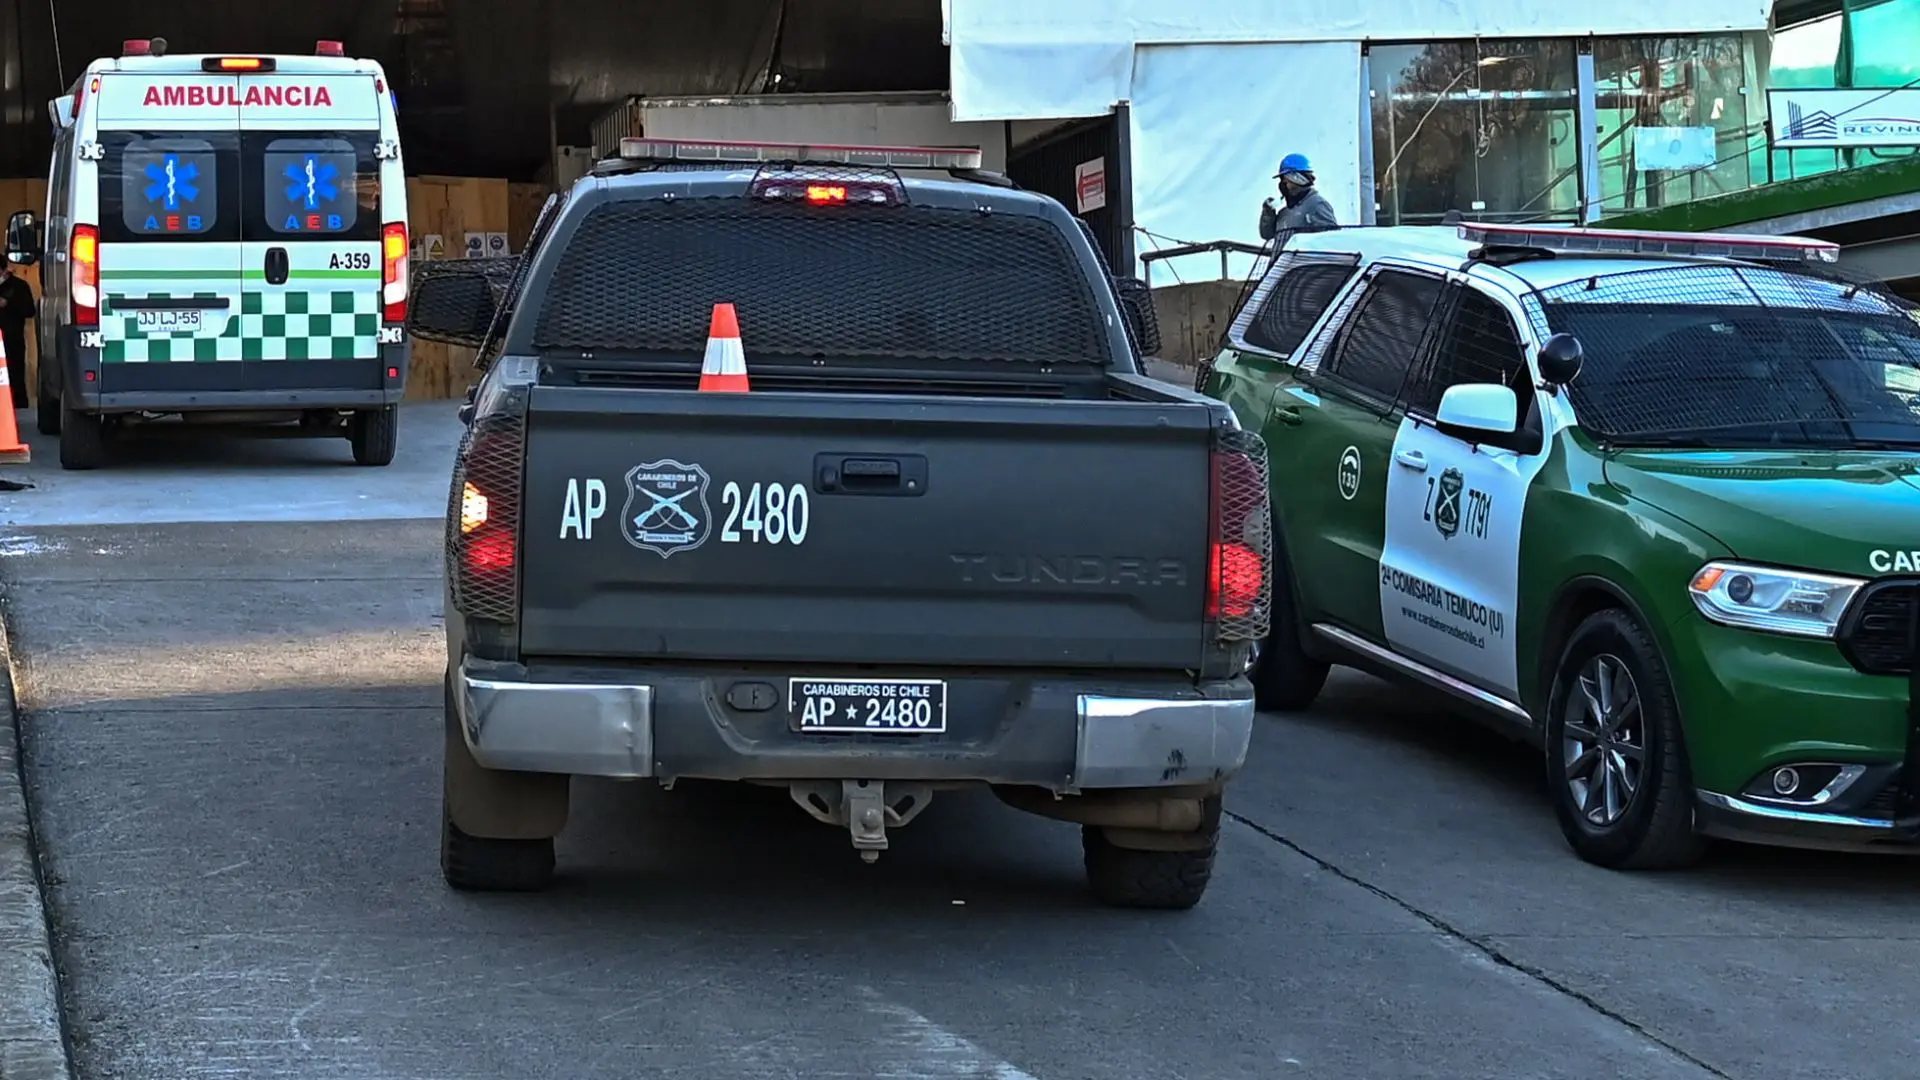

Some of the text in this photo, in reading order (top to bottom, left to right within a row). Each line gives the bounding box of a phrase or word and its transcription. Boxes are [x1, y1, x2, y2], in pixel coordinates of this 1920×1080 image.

[143, 85, 332, 107] AMBULANCIA
[329, 252, 371, 270] A-359
[657, 481, 677, 489] CHILE
[1342, 471, 1357, 489] 133
[560, 478, 809, 545] AP 2480
[1423, 476, 1492, 540] Z 7791
[950, 552, 1187, 585] TUNDRA
[1392, 570, 1443, 609] COMISARIA
[1444, 590, 1487, 627] TEMUCO
[1489, 609, 1504, 639] (U)
[803, 684, 931, 697] CARABINEROS DE CHILE
[801, 697, 931, 727] AP 2480
